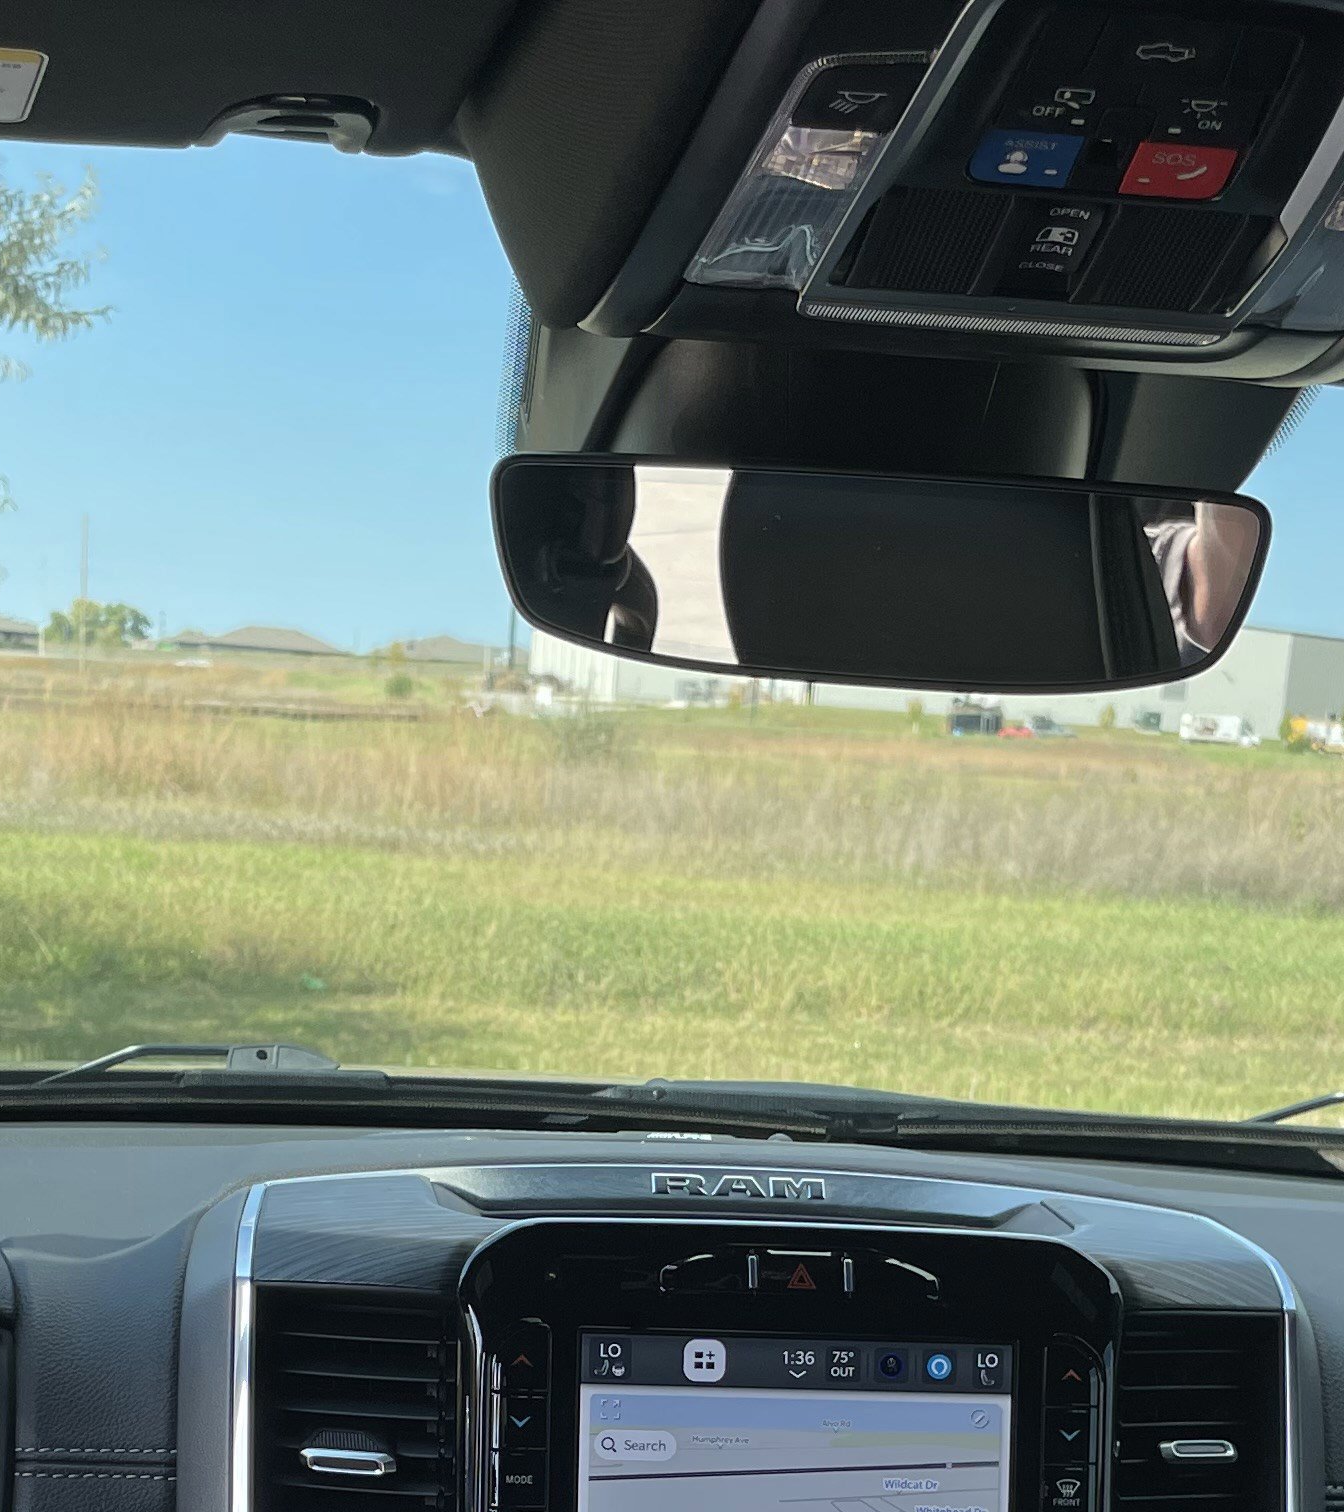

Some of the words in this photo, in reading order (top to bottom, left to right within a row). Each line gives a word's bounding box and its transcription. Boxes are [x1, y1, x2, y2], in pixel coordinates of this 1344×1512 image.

[1032, 105, 1065, 118] OFF
[1197, 120, 1223, 131] ON
[1005, 138, 1058, 150] ASSIST
[1152, 151, 1197, 167] SOS
[1049, 207, 1091, 220] OPEN
[1030, 243, 1073, 256] REAR
[1018, 260, 1064, 273] CLOSE
[651, 1172, 827, 1200] RAM
[599, 1343, 622, 1359] LO
[832, 1350, 855, 1364] 75°
[782, 1350, 815, 1366] 1:36
[977, 1353, 999, 1368] LO
[830, 1366, 855, 1378] OUT
[624, 1439, 667, 1453] Search
[505, 1475, 533, 1485] MODE
[884, 1478, 923, 1491] Wildcat
[925, 1479, 938, 1491] Dr
[1052, 1498, 1080, 1507] FRONT
